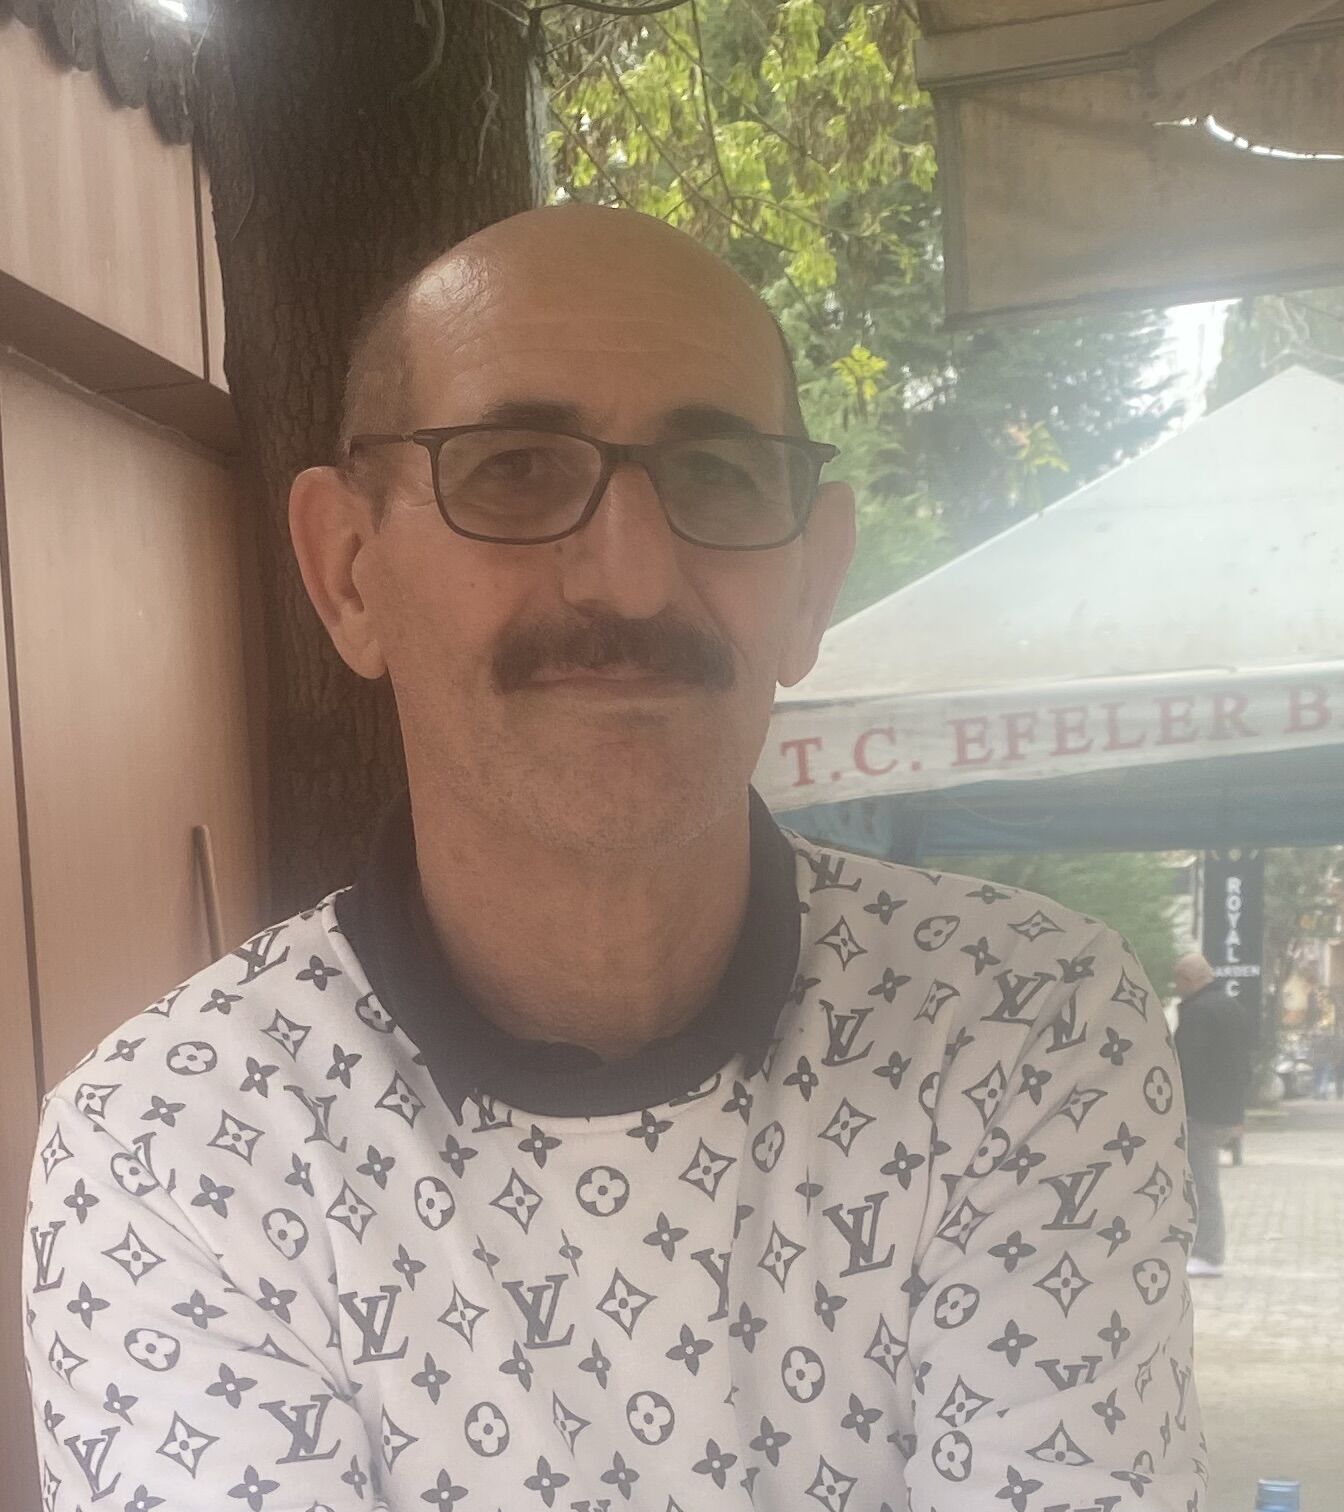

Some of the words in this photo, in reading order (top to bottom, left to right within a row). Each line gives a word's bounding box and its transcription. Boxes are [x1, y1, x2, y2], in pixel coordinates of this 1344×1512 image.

[780, 726, 923, 787] T.C.
[948, 692, 1258, 768] EFELER
[1225, 876, 1242, 963] ROYAL
[822, 1191, 896, 1278] LV
[339, 1285, 409, 1365] LV
[502, 1274, 576, 1350] LV
[258, 1394, 342, 1464] LV
